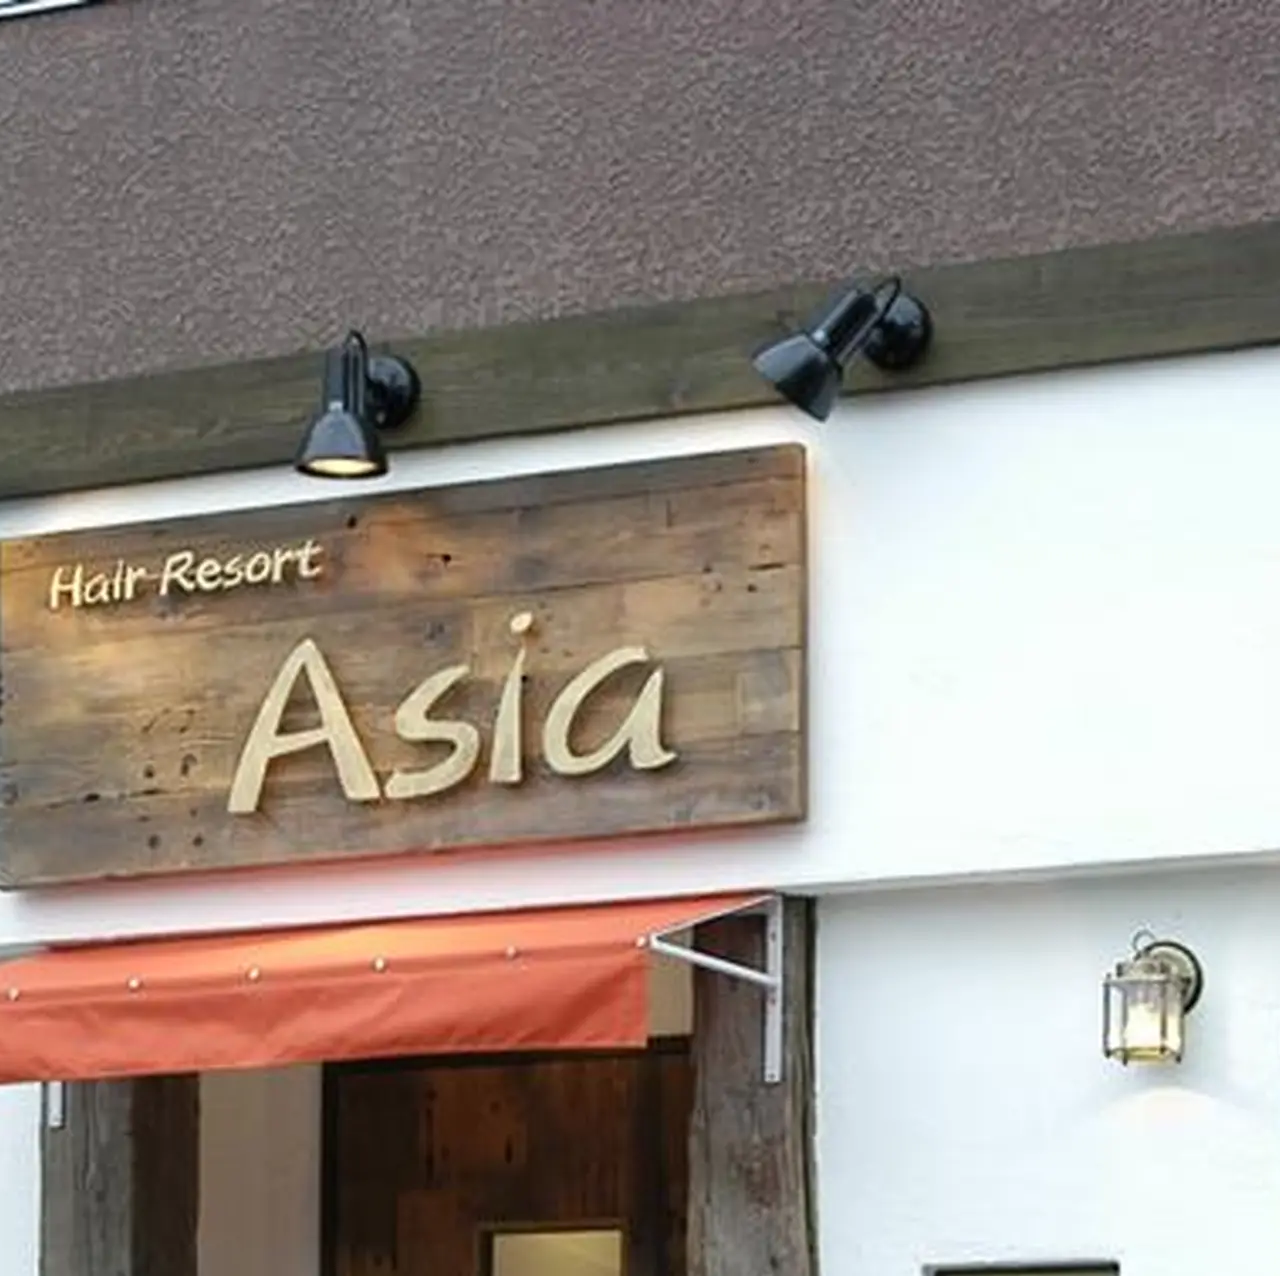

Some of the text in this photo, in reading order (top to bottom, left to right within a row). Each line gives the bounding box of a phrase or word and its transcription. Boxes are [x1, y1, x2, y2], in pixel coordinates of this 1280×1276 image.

[48, 539, 323, 609] Hair Resort
[226, 611, 677, 813] Asia
